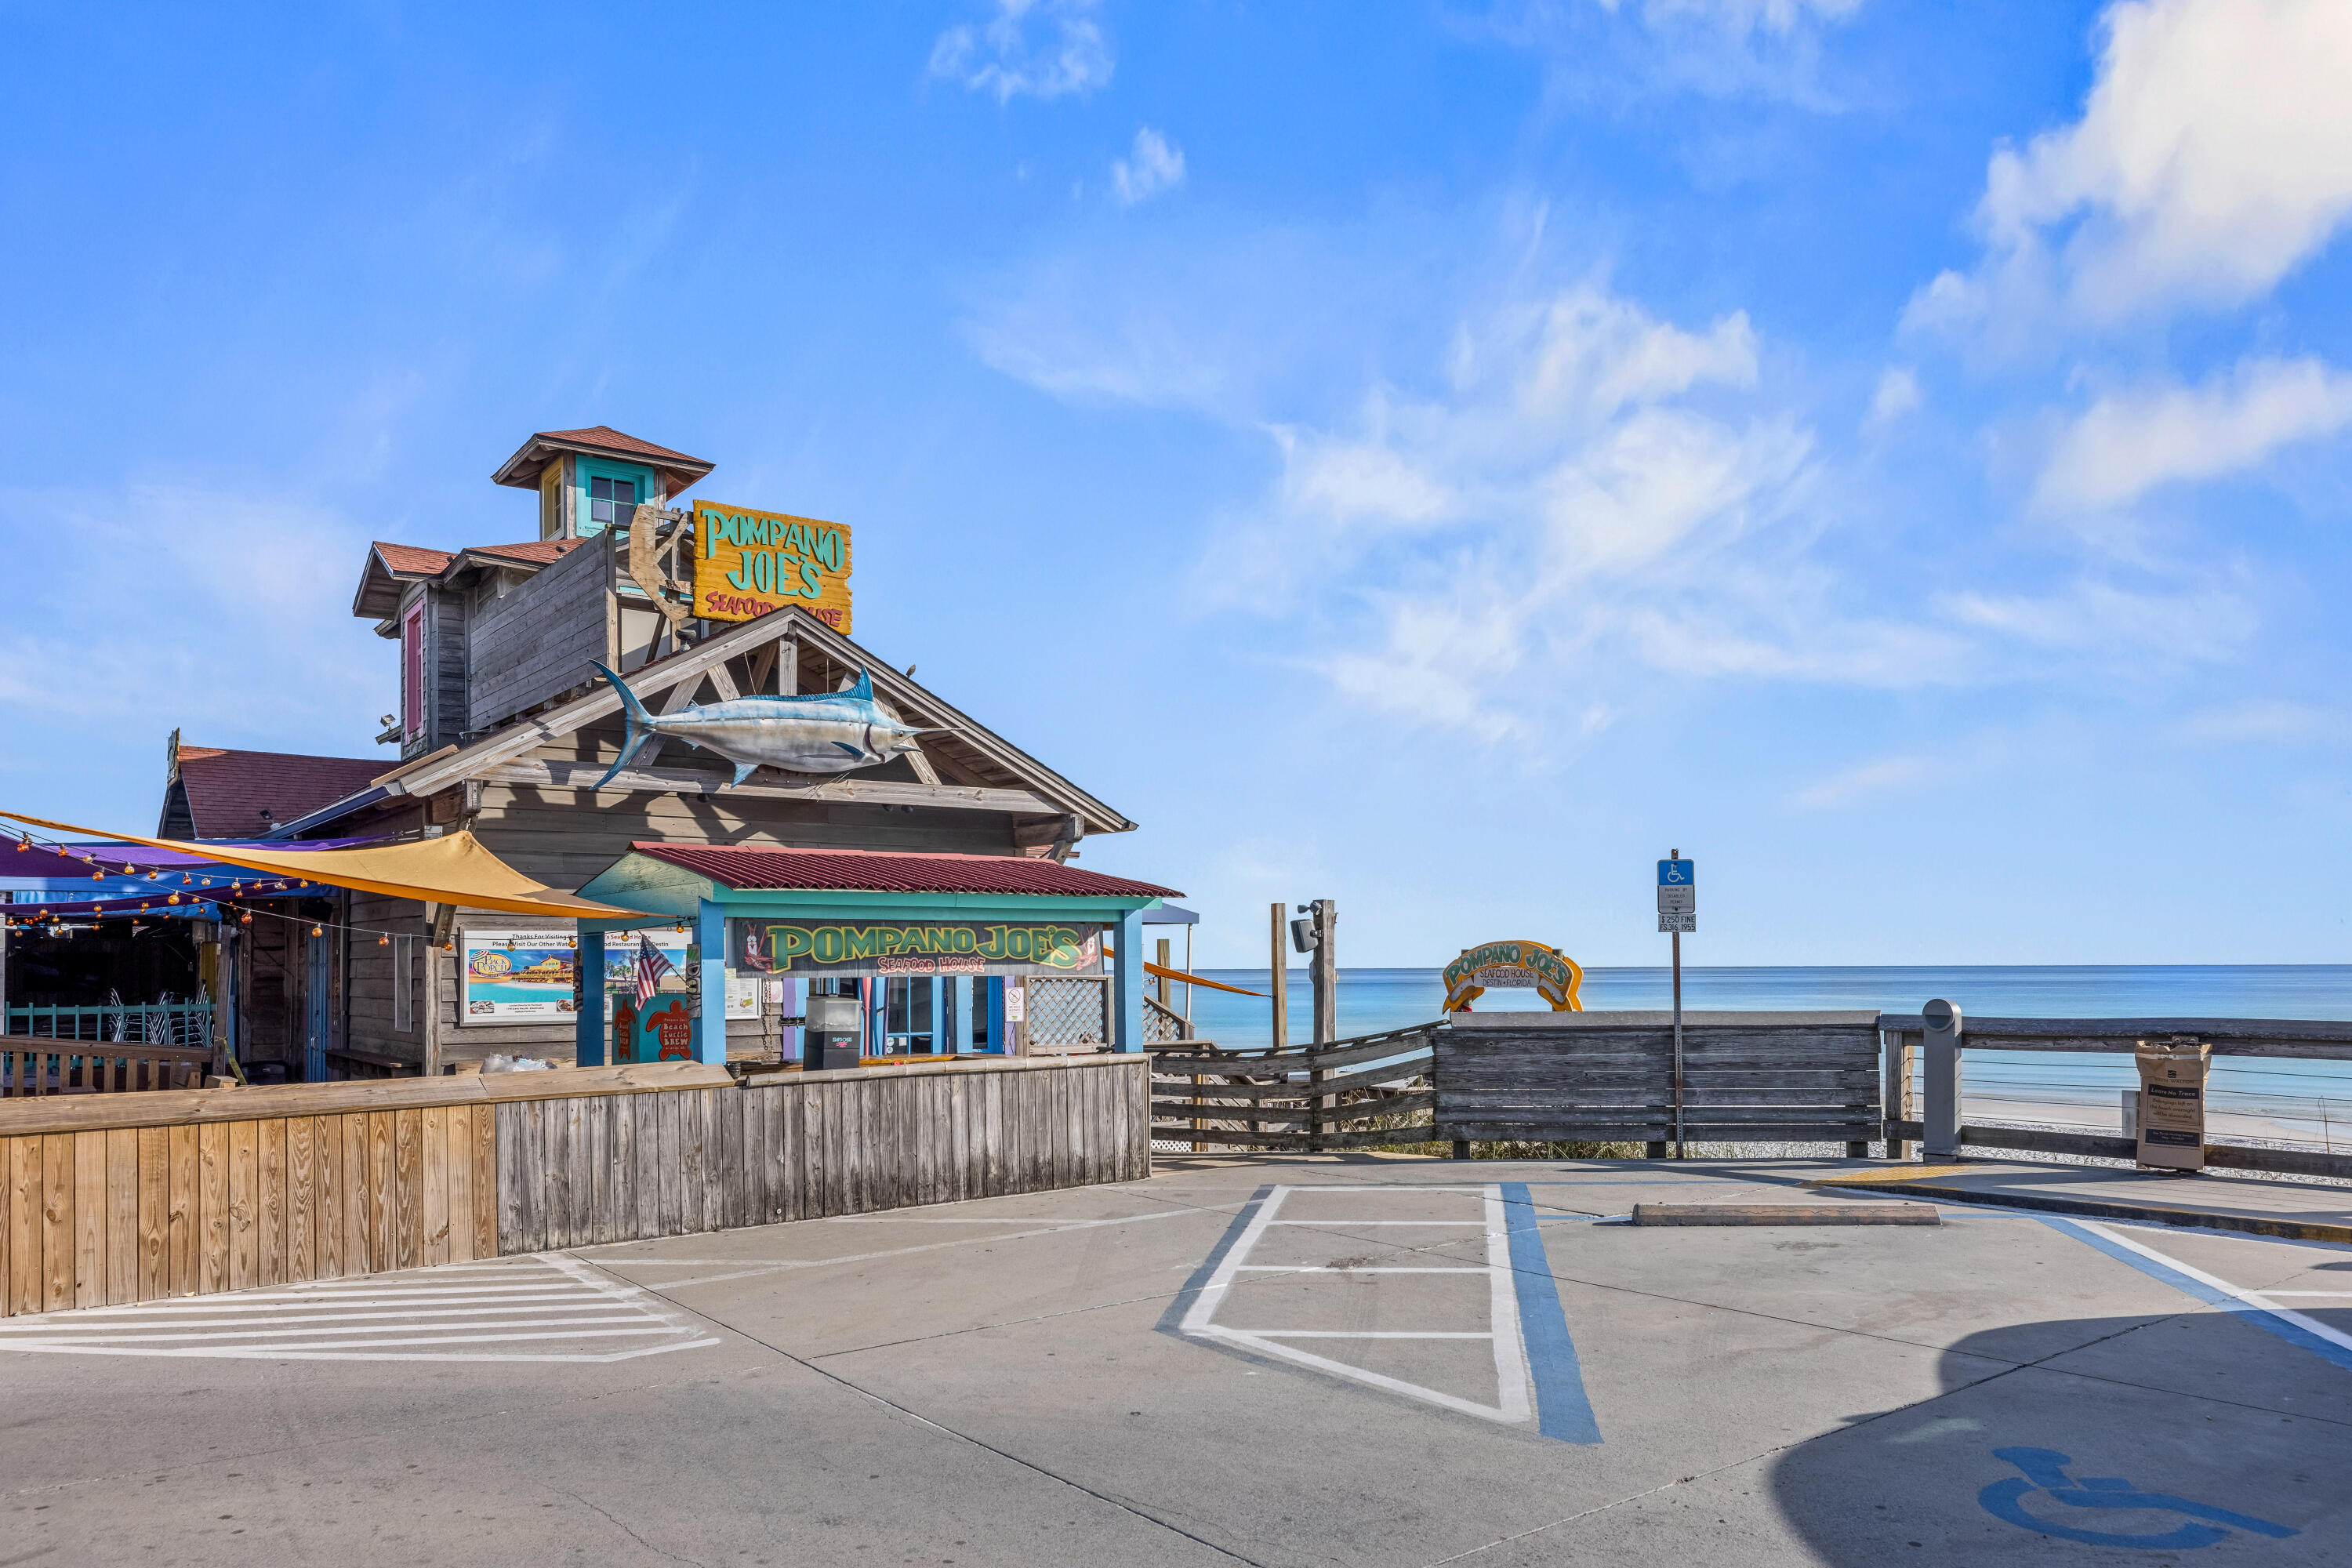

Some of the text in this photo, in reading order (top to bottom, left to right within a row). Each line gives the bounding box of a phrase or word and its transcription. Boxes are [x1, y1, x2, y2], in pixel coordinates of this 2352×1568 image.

[702, 509, 845, 572] POMPANO
[727, 550, 822, 599] JOE'S
[706, 591, 776, 617] SEAFOOD
[485, 956, 506, 965] BACK
[766, 925, 1083, 974] POMPANO JOE'S
[477, 962, 507, 971] PORCH
[878, 956, 985, 973] SEAFOOD HOUSE
[1445, 943, 1569, 986] POMPANO JOE'S
[1480, 969, 1534, 978] SEAFOOD HOUSE
